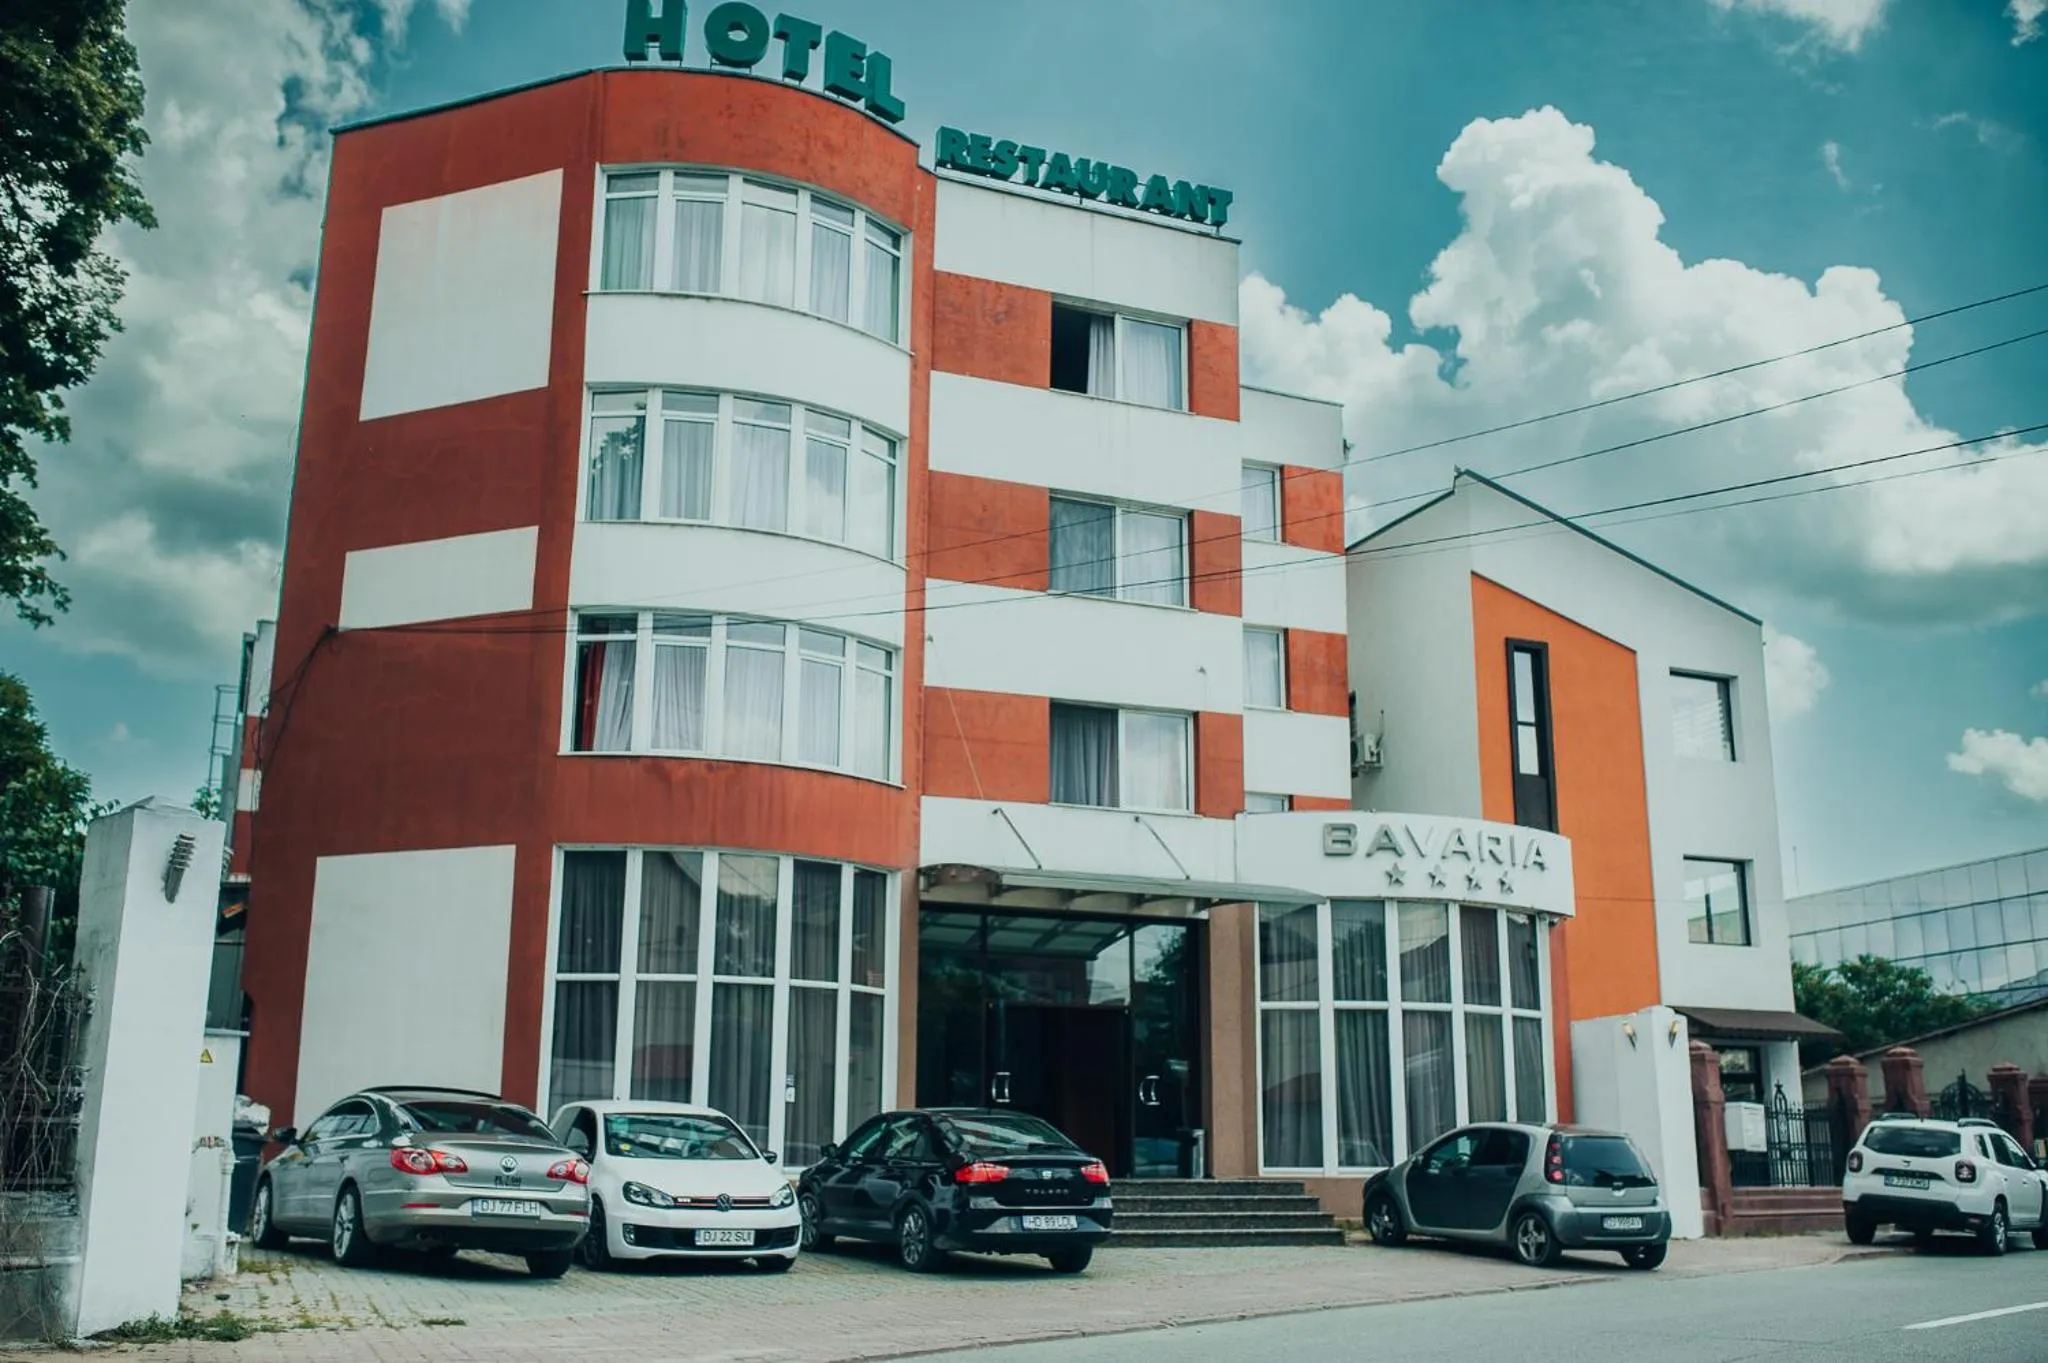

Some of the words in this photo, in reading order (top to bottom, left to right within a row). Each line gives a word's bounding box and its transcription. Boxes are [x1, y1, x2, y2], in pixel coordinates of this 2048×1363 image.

[623, 0, 905, 124] HOTEL
[936, 126, 1233, 227] RESTAURANT
[1323, 823, 1547, 872] BAVARIA
[481, 1200, 496, 1212] DJ
[499, 1201, 513, 1212] 77
[703, 1231, 718, 1242] DJ
[720, 1231, 733, 1242] 22
